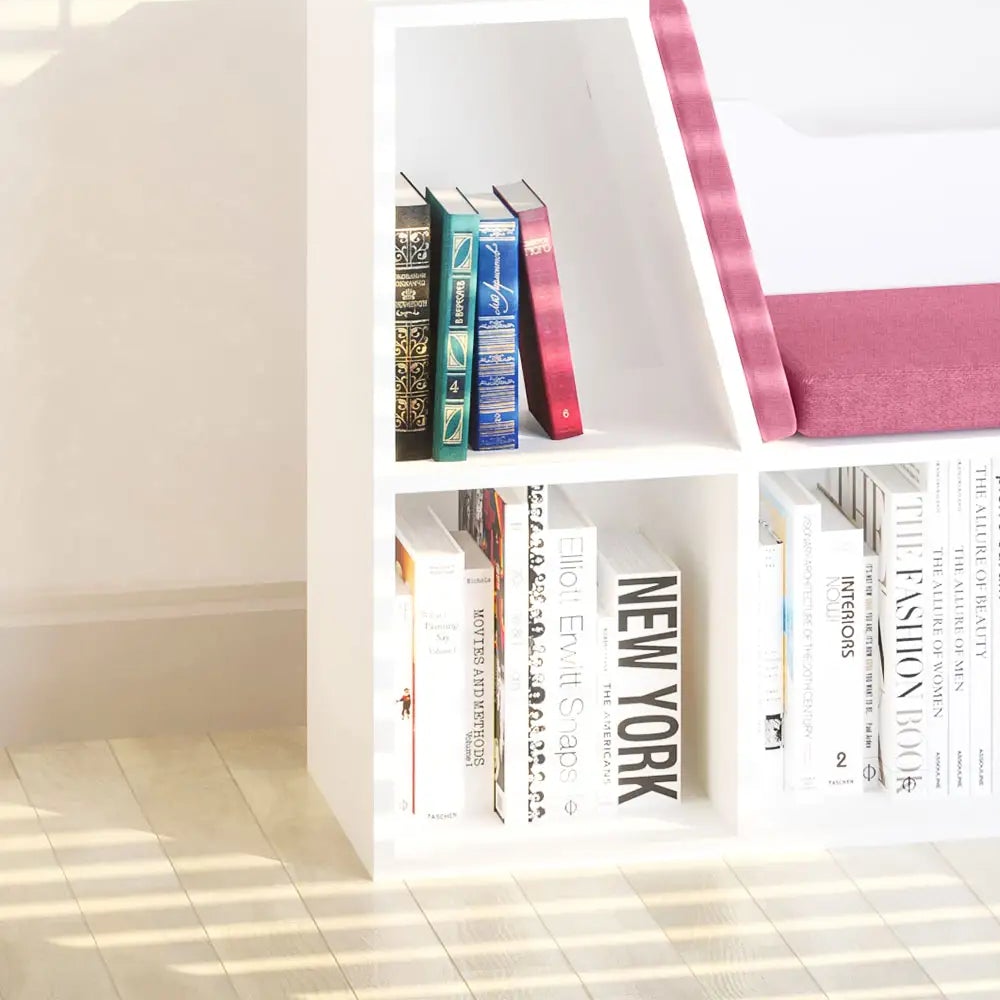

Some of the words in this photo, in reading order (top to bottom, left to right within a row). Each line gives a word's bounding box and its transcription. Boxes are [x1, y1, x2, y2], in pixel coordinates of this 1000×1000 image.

[449, 381, 459, 393] 4
[975, 464, 987, 499] THE
[896, 496, 923, 561] THE
[975, 503, 987, 566] ALLURE
[559, 536, 584, 606] Elliott
[932, 546, 944, 577] THE
[954, 545, 965, 576] THE
[975, 569, 987, 591] OF
[617, 574, 679, 671] NEW
[841, 575, 855, 659] INTERIORS
[896, 568, 924, 699] FASHION
[932, 580, 944, 636] ALLURE
[954, 579, 965, 636] ALLURE
[975, 595, 987, 659] BEAUTY
[473, 608, 485, 665] MOVIES
[559, 615, 584, 689] Erwitt
[932, 639, 944, 659] OF
[954, 638, 965, 658] OF
[473, 668, 485, 700] AND
[602, 684, 612, 708] THE
[932, 661, 944, 718] WOMEN
[954, 660, 965, 692] MEN
[473, 700, 485, 767] METHODS
[554, 697, 584, 785] Snaps
[602, 710, 612, 786] AMERICANS
[616, 683, 680, 806] YORK
[836, 751, 848, 768] 2
